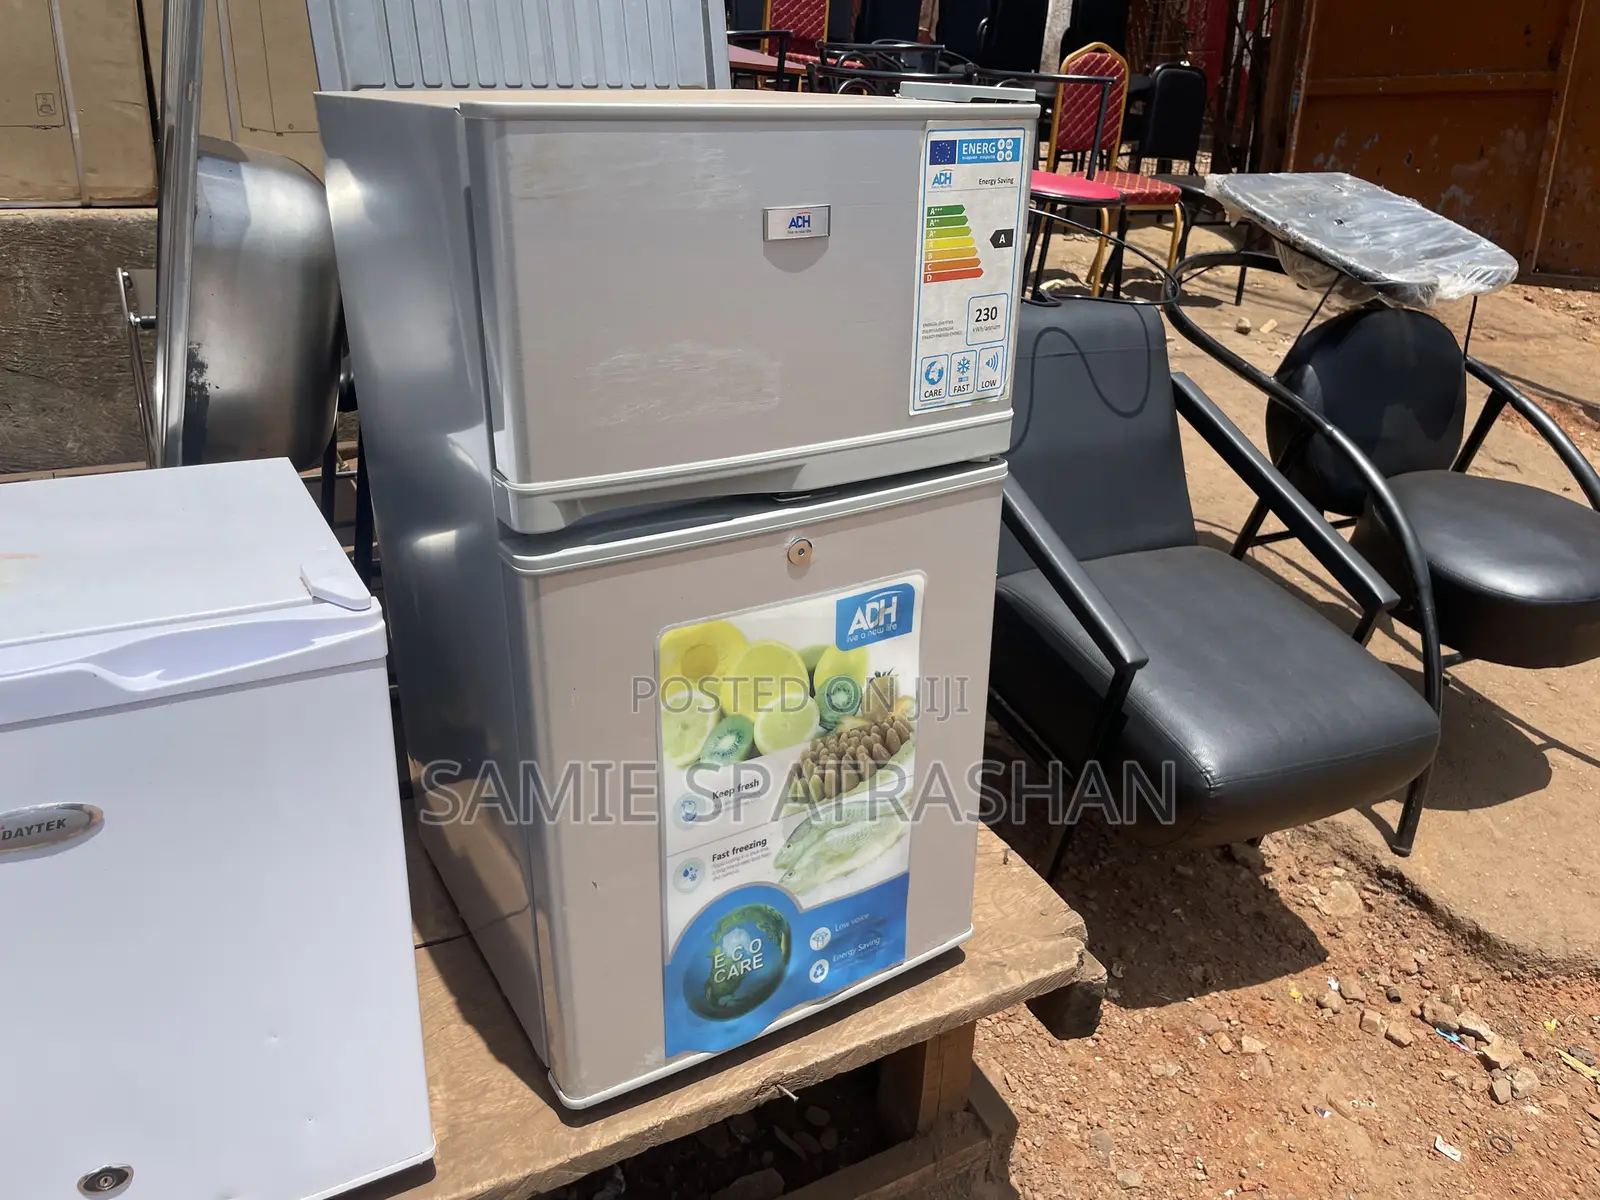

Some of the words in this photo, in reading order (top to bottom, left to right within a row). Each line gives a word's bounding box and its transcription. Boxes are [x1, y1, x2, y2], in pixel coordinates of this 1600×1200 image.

[962, 142, 996, 155] ENERG
[978, 178, 996, 186] Energy
[997, 177, 1014, 185] Saving
[998, 233, 1006, 244] A
[927, 263, 932, 271] C
[926, 274, 933, 282] D
[975, 306, 998, 323] 230
[953, 383, 970, 394] FAST
[981, 379, 998, 389] LOW
[924, 388, 943, 399] CARE
[712, 787, 736, 801] Keep
[737, 778, 760, 793] fresh
[1, 818, 67, 841] DAYTEK
[712, 850, 730, 862] Fast
[731, 838, 768, 856] freezing
[834, 923, 850, 932] Low
[850, 912, 870, 925] voice
[832, 947, 857, 963] Energy
[857, 937, 881, 952] Saving
[713, 953, 764, 984] CARE
